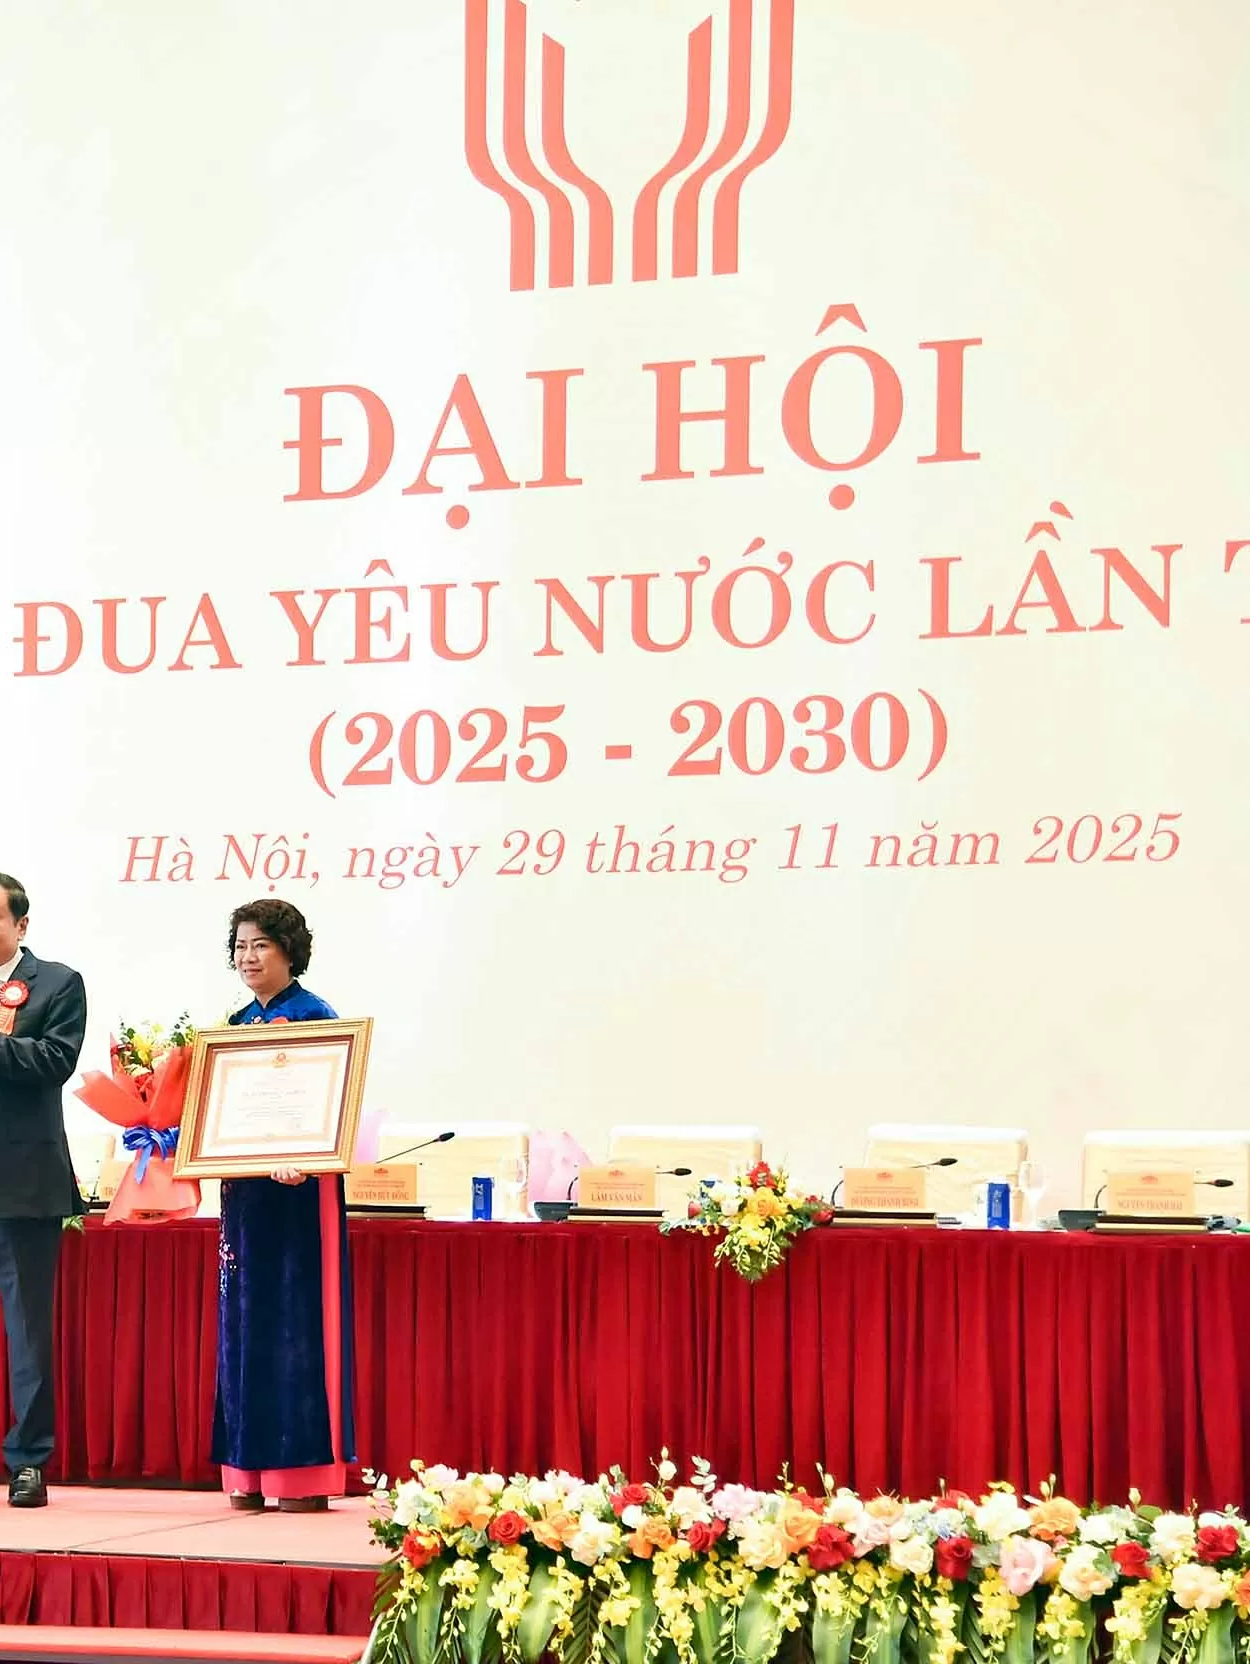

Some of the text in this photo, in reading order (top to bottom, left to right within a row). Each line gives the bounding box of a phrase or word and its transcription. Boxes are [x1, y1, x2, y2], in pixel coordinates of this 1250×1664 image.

[282, 303, 983, 530] ĐẠI HỘI
[13, 592, 243, 676] ĐUA
[270, 559, 500, 667] YÊU
[533, 536, 876, 657] NƯỚC
[919, 500, 1183, 640] LẦN
[309, 688, 949, 799] (2025 - 2030)
[119, 812, 1183, 892] Hà Nội, ngày 29 tháng 11 năm 2025
